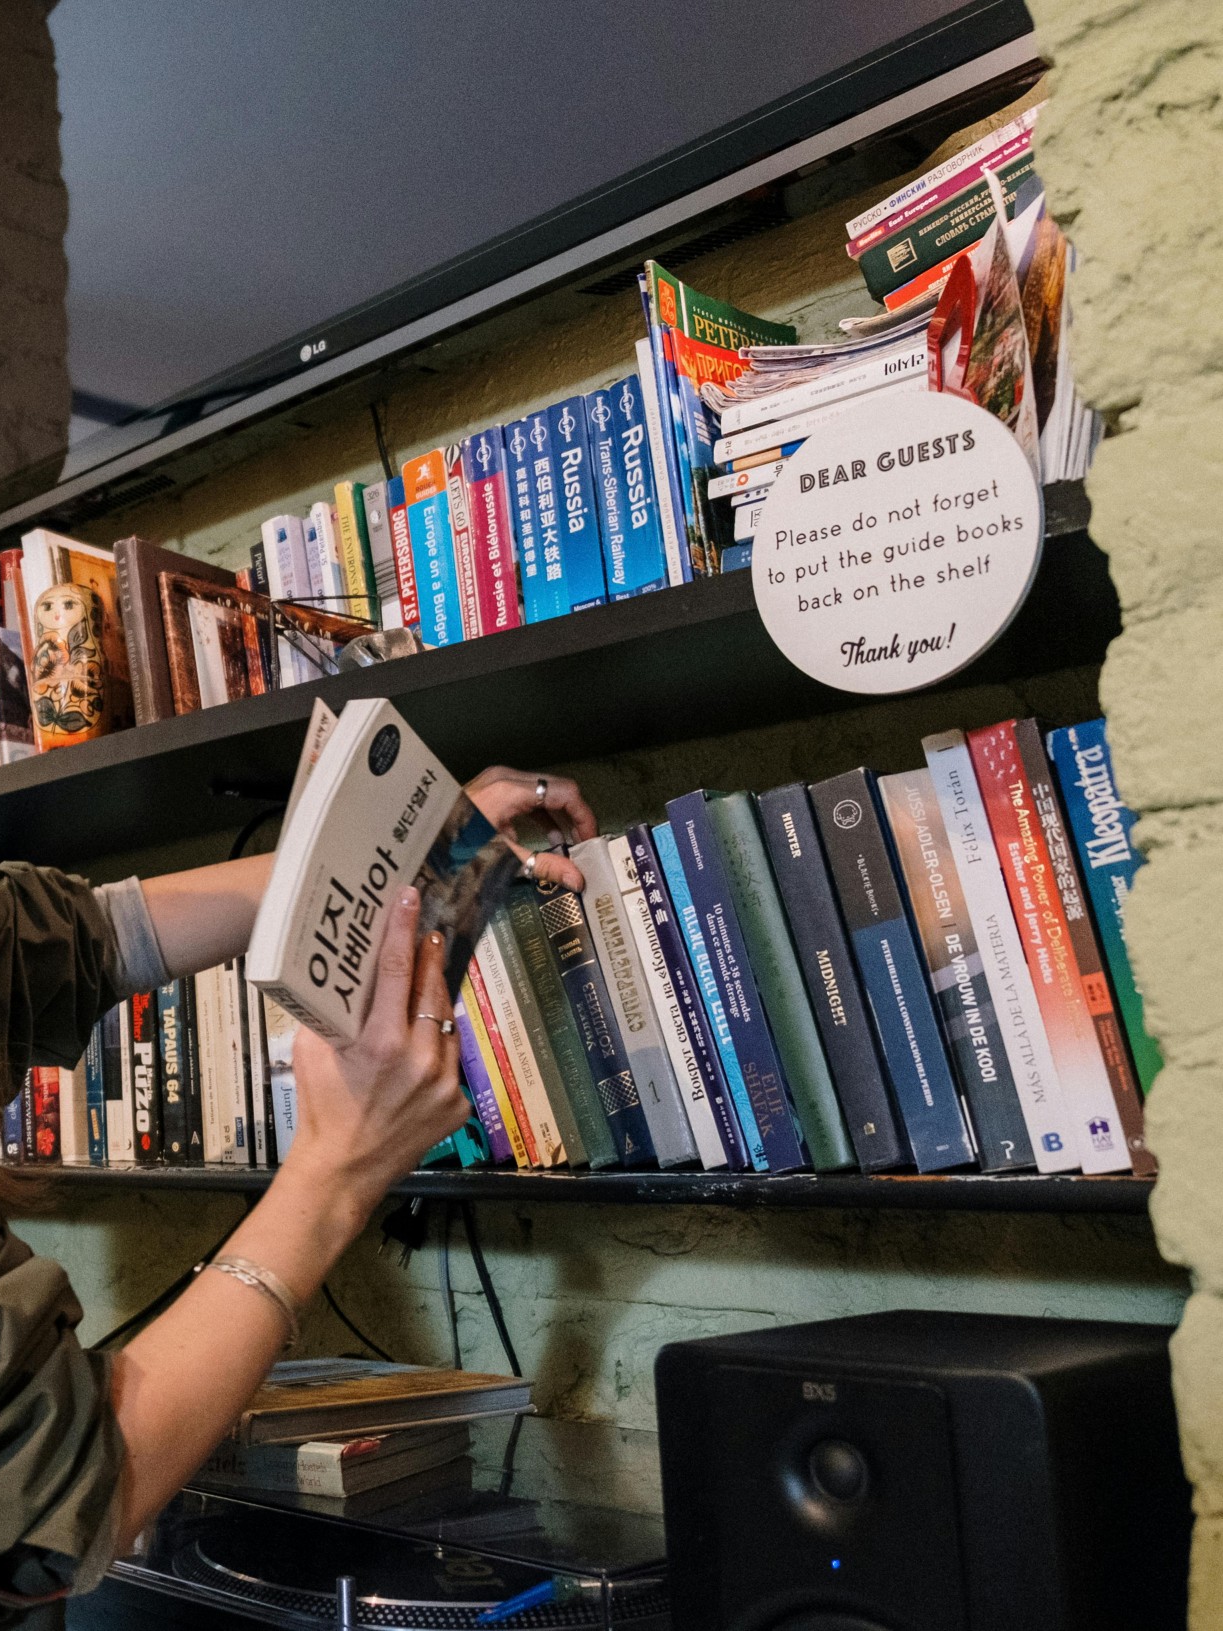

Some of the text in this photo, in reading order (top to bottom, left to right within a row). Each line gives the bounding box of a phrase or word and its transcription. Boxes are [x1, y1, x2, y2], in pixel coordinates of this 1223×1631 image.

[850, 144, 986, 232] РУССКО ФИНСКИЙ РАЗГОВОРНИК
[886, 213, 904, 228] East
[902, 193, 939, 219] European
[933, 216, 977, 247] СЛОВАРЬ С
[312, 340, 326, 355] LG
[559, 446, 590, 533] Russia
[619, 422, 654, 529] Russia
[800, 459, 867, 494] DEAR
[877, 429, 976, 473] GUESTS
[313, 512, 327, 553] Petersburg
[448, 478, 466, 527] LET'S GO
[531, 455, 563, 581] 西伯利亚大铁路
[598, 436, 626, 586] Trans-Siberian Railway
[775, 479, 1000, 551] Please do not forget
[340, 514, 357, 584] THE ENVIRONS
[420, 505, 449, 646] Europe on a Budget
[457, 532, 474, 596] EUROPEAN
[479, 482, 508, 627] Russie et Biélorussie
[767, 513, 1024, 585] to put the guide books
[118, 556, 132, 612] СТЕНА
[797, 554, 990, 613] back on the shelf
[840, 622, 957, 667] Thank you!
[392, 769, 438, 844] 횡단열차
[945, 769, 982, 864] Félix Torán
[1007, 779, 1027, 806] The
[1074, 744, 1132, 869] Kleopatra
[683, 819, 707, 871] Flammarion
[780, 812, 802, 859] HUNTER
[904, 785, 953, 919] JUSSI ADLER-OLSEN
[1011, 806, 1040, 864] Amazing
[642, 871, 669, 926] 安魂曲
[854, 856, 880, 913] BLACKIE BOOKS
[1007, 840, 1055, 984] Esther and Jerry Hicks
[1030, 863, 1053, 907] Power
[308, 877, 355, 988] 이지
[333, 845, 400, 1014] 시베리아
[634, 896, 670, 981] «Коршуне»
[1041, 908, 1058, 926] of
[487, 962, 508, 995] DAVIES
[591, 892, 648, 1034] СУПЕРДЕТЕКТИВ
[661, 980, 674, 999] на
[704, 911, 743, 1019] dans ce monde étrange
[712, 903, 754, 1023] 10 minutes et 38 secondes
[815, 949, 847, 1027] MIDNIGHT
[1045, 925, 1076, 997] Deliberate
[499, 999, 514, 1020] THE
[505, 1019, 525, 1050] REBEL
[574, 1000, 597, 1051] Уилки
[580, 981, 616, 1059] КОЛЛИНЗ
[666, 1003, 688, 1044] света
[879, 938, 934, 1107] PETER HELLER LA CONSTELACIÓN DEL PERRO
[943, 932, 999, 1084] DE VROUW IN DE KOOI
[984, 913, 1047, 1105] MÁS ALLÁ DE LA MATERIA
[162, 1006, 177, 1075] TAPAUS
[515, 1050, 537, 1087] ANGELS
[145, 1067, 153, 1100] Mario
[165, 1078, 178, 1103] 64
[648, 1080, 661, 1104] 1
[678, 1046, 706, 1101] Вокруг
[741, 1060, 776, 1137] SHAFAK
[759, 1071, 785, 1118] ELIF
[280, 1086, 296, 1131] Jumper
[1041, 1132, 1064, 1153] B
